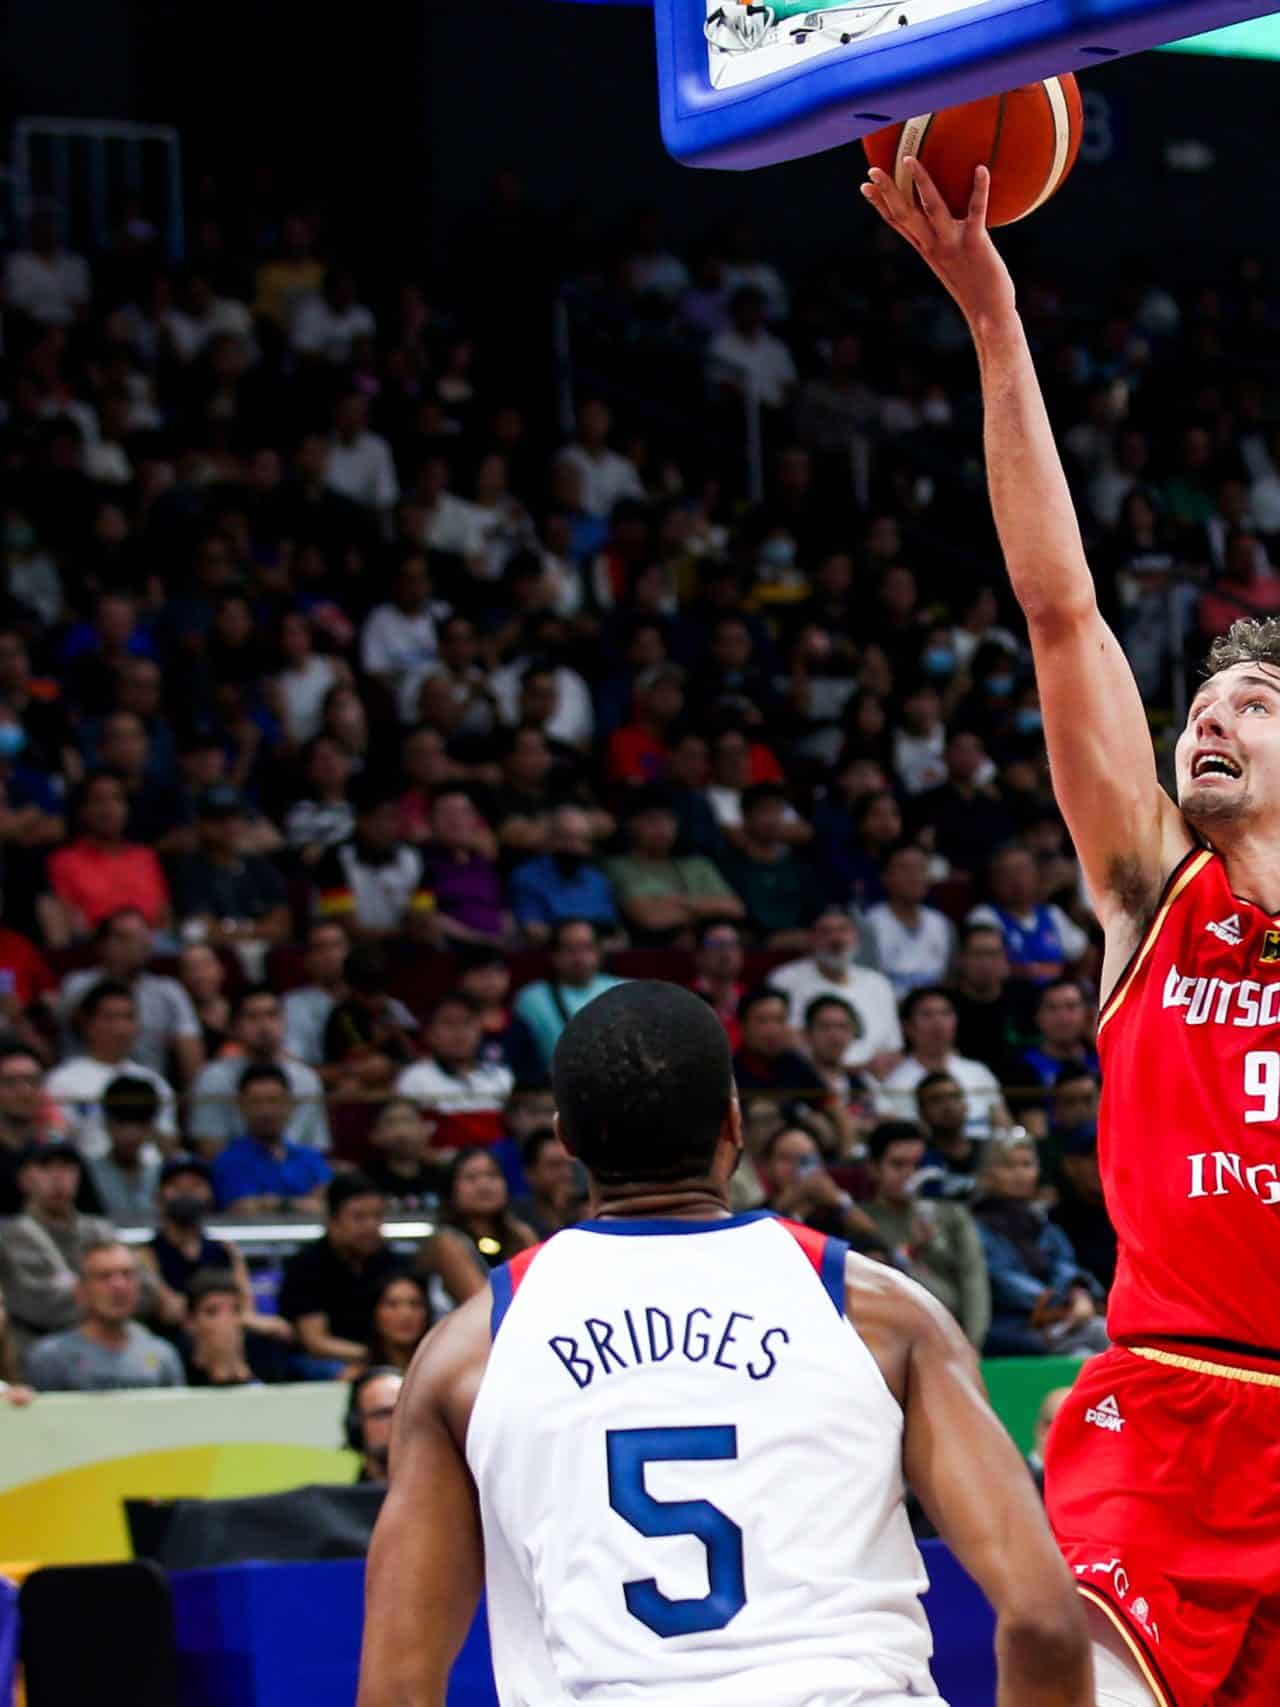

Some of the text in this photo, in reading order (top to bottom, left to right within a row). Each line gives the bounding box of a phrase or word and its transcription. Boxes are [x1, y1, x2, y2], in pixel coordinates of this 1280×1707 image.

[1243, 1050, 1280, 1124] 9
[548, 1307, 790, 1390] BRIDGES
[1084, 1407, 1127, 1433] PEAK
[605, 1424, 748, 1640] 5
